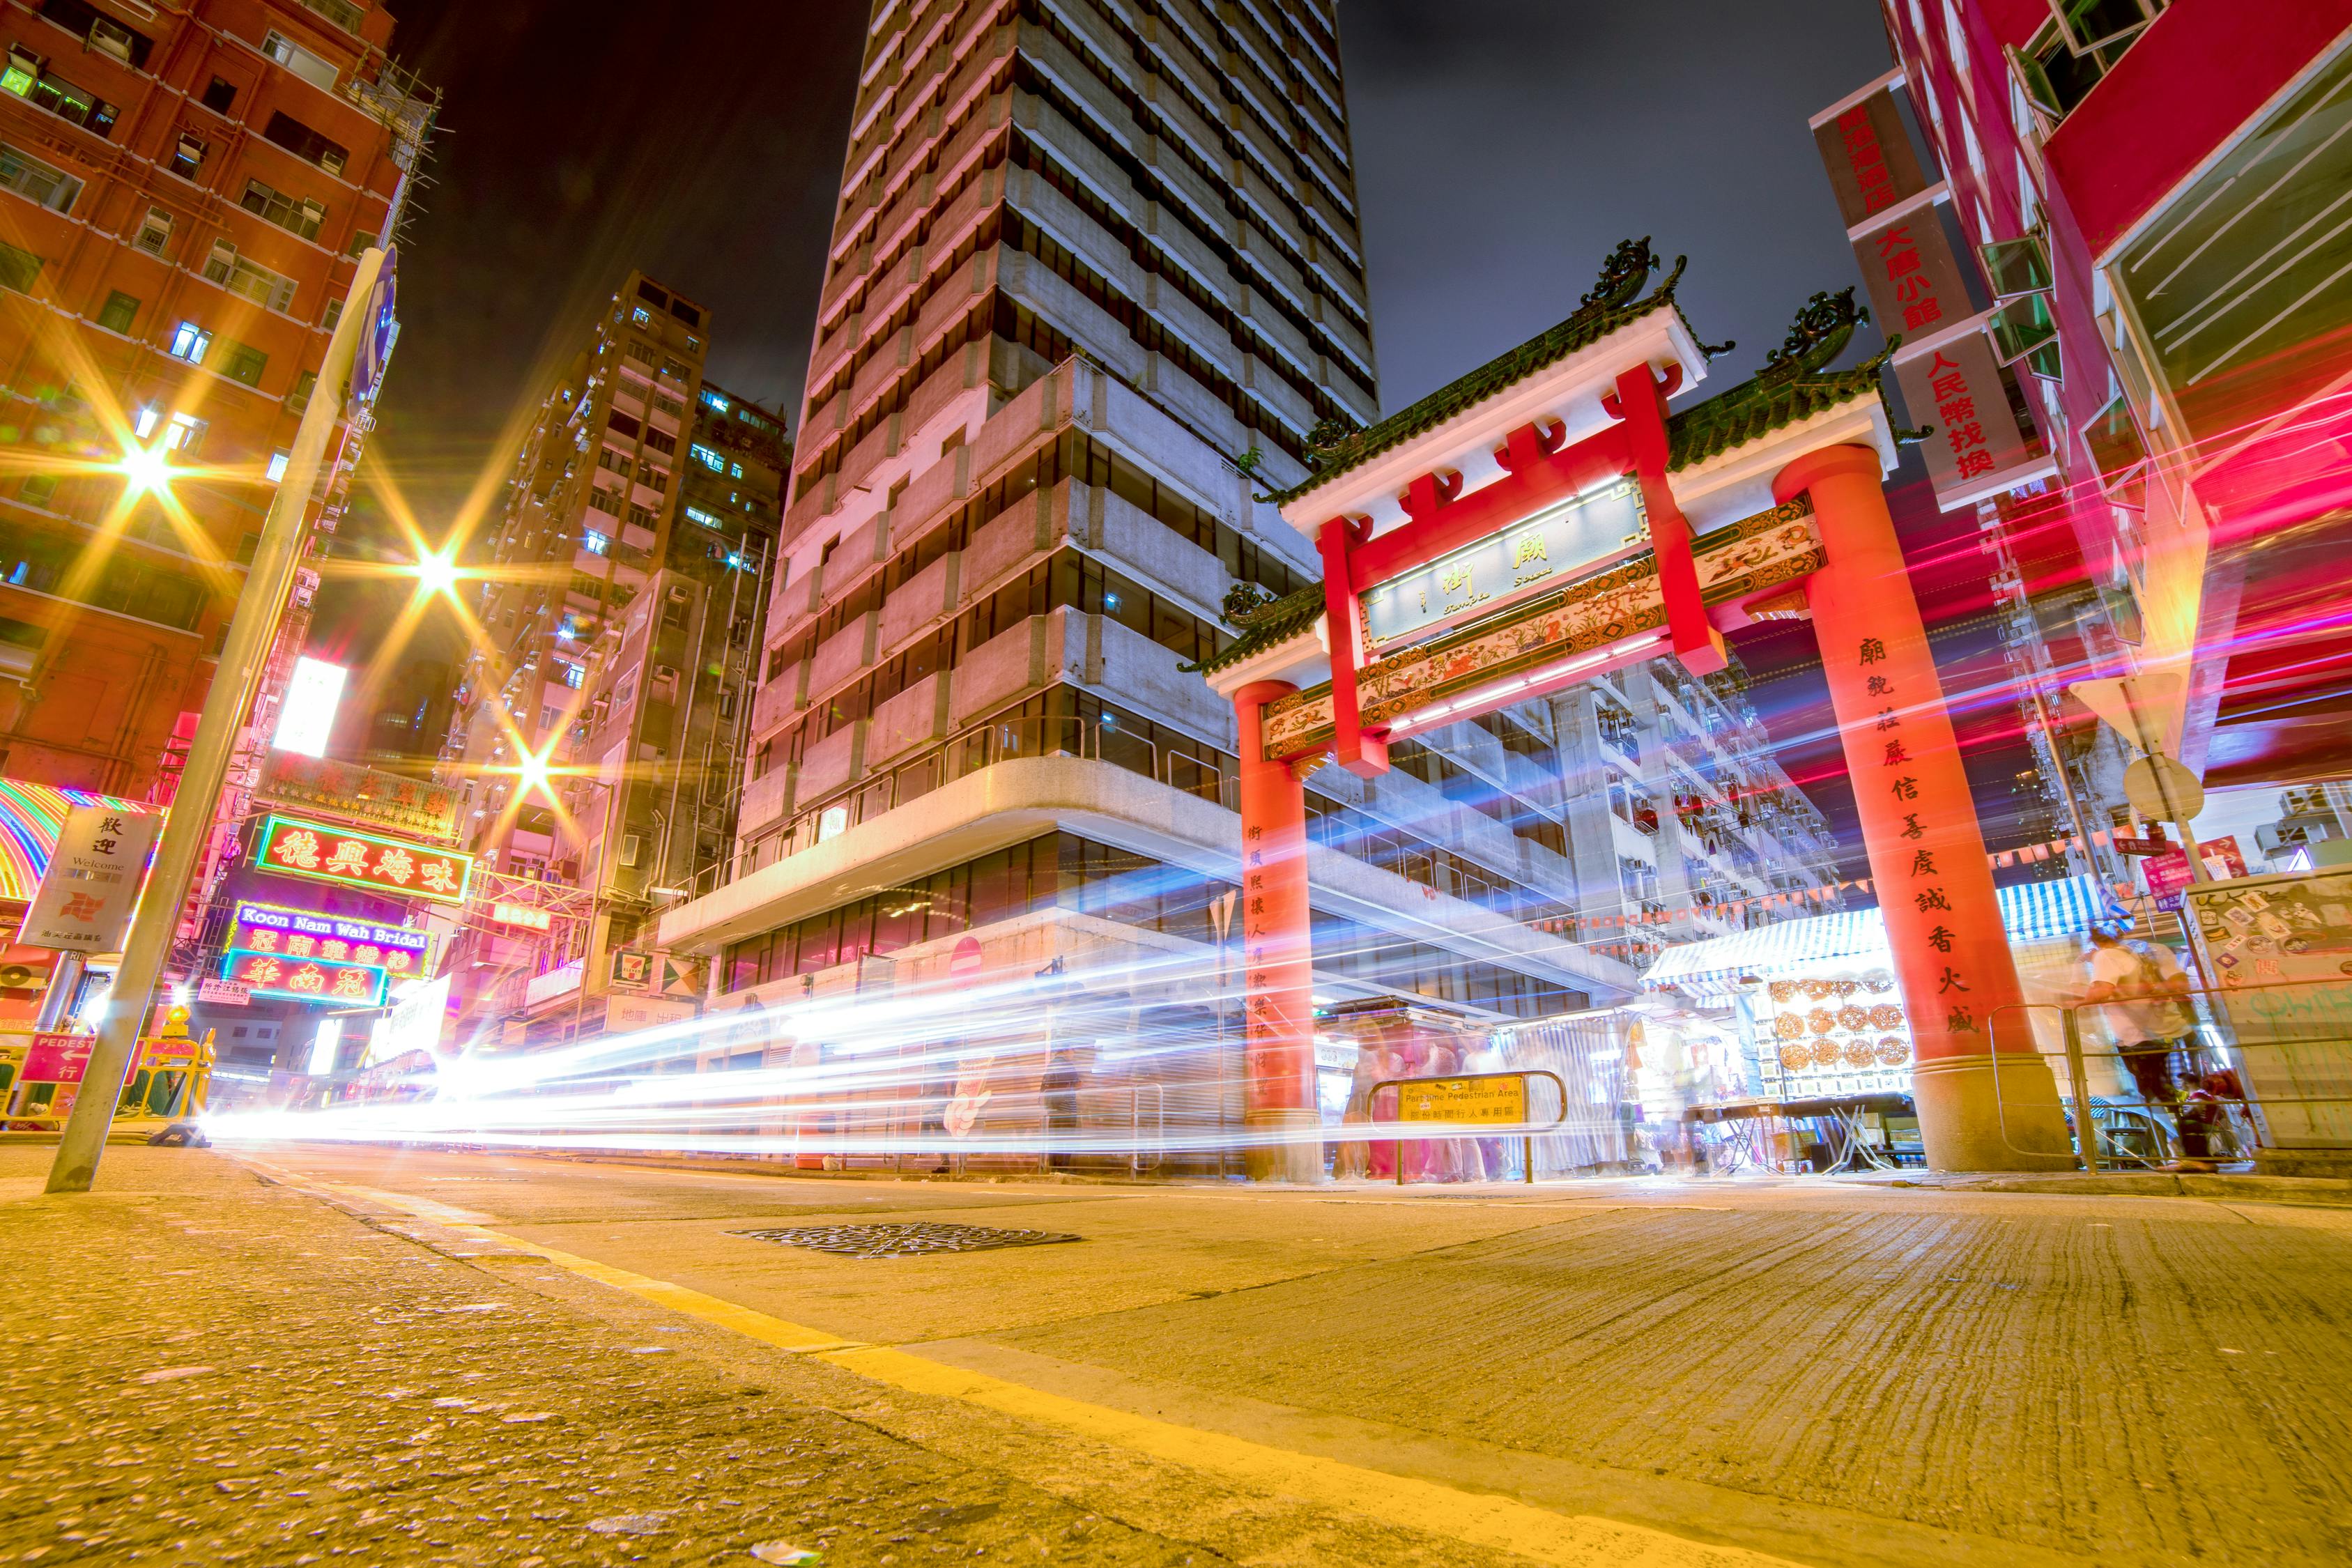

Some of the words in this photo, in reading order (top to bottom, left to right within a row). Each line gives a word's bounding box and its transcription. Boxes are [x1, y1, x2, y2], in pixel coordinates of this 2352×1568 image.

[1875, 226, 1943, 330] 大唐小館
[1928, 351, 1996, 480] 人民幣找換
[92, 817, 123, 855] 歡迎
[73, 856, 125, 872] Welcome
[274, 831, 459, 892] 德興海味
[243, 909, 289, 927] Koon
[295, 916, 332, 933] Nam
[337, 922, 369, 939] Wah
[374, 928, 426, 948] Bridal
[249, 929, 411, 970] 冠南華婚紗
[622, 1008, 647, 1022] 地庫
[656, 1010, 682, 1024] 出租
[59, 1066, 77, 1079] 行
[1447, 1091, 1494, 1100] Pedestrian
[1498, 1089, 1519, 1098] Area
[1411, 1107, 1514, 1121] 部份時間行人專用區
